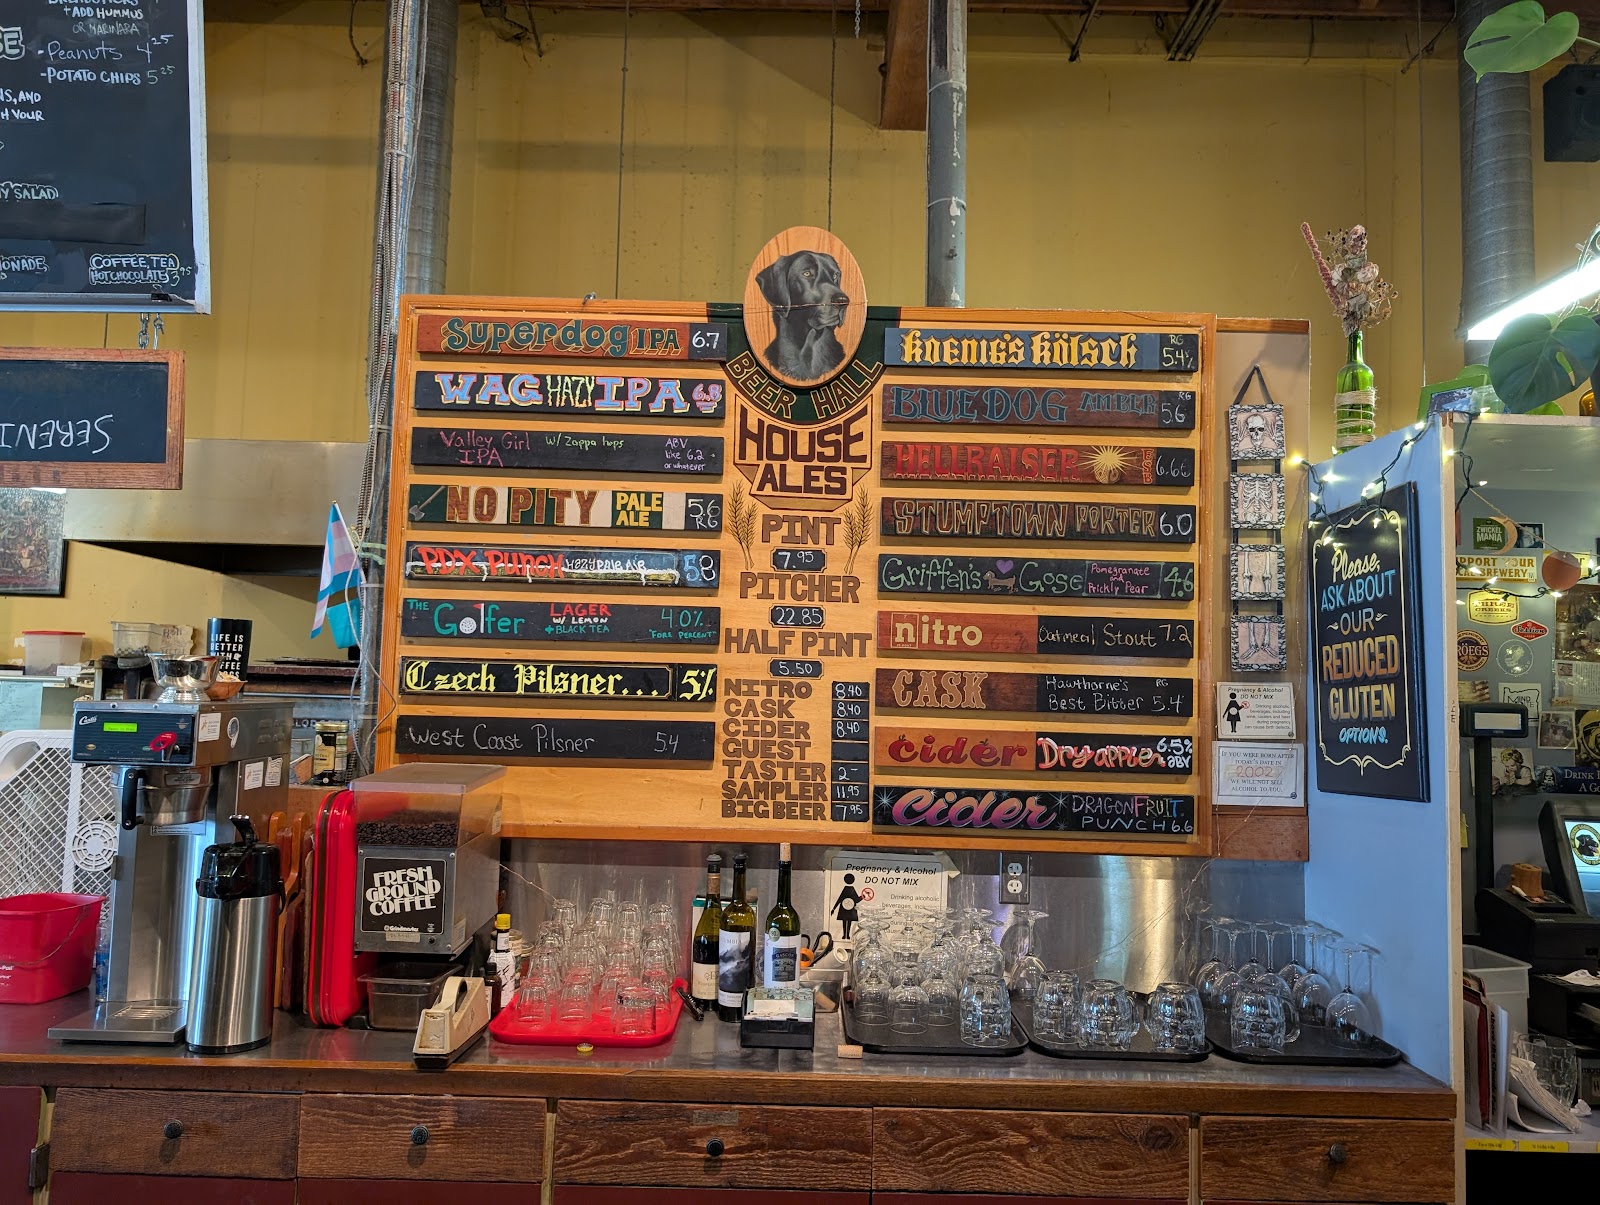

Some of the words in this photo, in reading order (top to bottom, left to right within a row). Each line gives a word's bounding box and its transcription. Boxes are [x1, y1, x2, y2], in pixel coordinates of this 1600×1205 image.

[96, 8, 144, 19] HUMMUS
[72, 25, 86, 34] OR
[88, 22, 140, 36] MARINARA
[100, 72, 141, 85] CHIPS
[19, 91, 42, 104] AND
[12, 109, 45, 121] YOUR
[14, 188, 56, 200] SALAD
[152, 257, 175, 269] TEA
[441, 317, 630, 358] Superdog
[630, 327, 683, 356] IPA
[691, 330, 720, 350] 6.7
[1169, 334, 1184, 346] RG
[435, 373, 543, 405] WAG
[546, 374, 596, 409] HAZY
[595, 376, 691, 414] IPA
[726, 350, 797, 419] BEER
[810, 359, 884, 419] HALL
[890, 386, 980, 421] BLUE
[982, 387, 1068, 423] DOG
[1079, 390, 1158, 416] AMBER
[1178, 391, 1192, 400] RG
[1161, 403, 1186, 424] 5.6
[439, 431, 493, 450] Valley
[502, 431, 531, 451] Girl
[565, 436, 597, 451] Zappa
[602, 436, 625, 449] hops
[665, 437, 689, 449] ABV
[739, 404, 868, 463] HOUSE
[459, 449, 504, 468] IPA
[665, 449, 681, 460] like
[687, 448, 705, 461] 6.2
[893, 443, 1081, 481] HELLRAISER
[673, 462, 706, 471] whatever
[1141, 448, 1154, 484] ESB
[756, 463, 847, 495] ALES
[446, 485, 499, 524] NO
[509, 487, 600, 526] PITY
[616, 491, 663, 513] PALE
[687, 498, 721, 518] 5.6
[615, 510, 650, 528] ALE
[696, 515, 718, 530] RG
[893, 499, 1068, 538] STUMPTOWN
[1075, 504, 1157, 538] PORTER
[1159, 510, 1193, 537] 6.0
[762, 514, 842, 546] PINT
[1476, 532, 1502, 543] MANIA
[417, 546, 480, 576] PDX
[683, 553, 716, 582] 5.8
[778, 551, 814, 570] 7.95
[1091, 562, 1151, 576] Pomegranate
[1331, 549, 1381, 583] Please,
[882, 557, 981, 591] Griffen's
[1019, 561, 1085, 595] Gose
[1110, 574, 1124, 583] and
[1163, 566, 1194, 597] 4.6
[1480, 569, 1528, 578] BREWERY
[740, 571, 861, 604] PITCHER
[1088, 581, 1121, 596] Prickly
[1125, 583, 1149, 594] Pear
[1321, 583, 1345, 612] ASK
[1347, 569, 1396, 605] ABOUT
[406, 599, 430, 611] THE
[550, 603, 612, 617] LAGER
[433, 603, 526, 636] Golfer
[571, 616, 609, 625] LEMON
[775, 606, 823, 625] 22.85
[1339, 607, 1375, 636] OUR
[211, 633, 231, 642] LIFE
[234, 634, 244, 642] IS
[589, 625, 610, 634] TEA
[894, 614, 983, 647] nitro
[1038, 624, 1095, 644] Oatmeal
[1103, 623, 1157, 648] Stout
[1158, 624, 1193, 648] 7.2
[210, 642, 244, 652] BETTER
[725, 628, 796, 655] HALF
[801, 631, 872, 658] PINT
[778, 661, 813, 676] 5.50
[1322, 634, 1400, 684] REDUCED
[406, 660, 497, 692] Czech
[679, 667, 717, 701] 5%
[1046, 675, 1129, 692] Hawthorne's
[1155, 679, 1169, 688] RG
[724, 678, 813, 699] NITRO
[834, 682, 862, 700] 8.40
[892, 670, 989, 710] CASK
[724, 698, 796, 719] CASK
[836, 701, 861, 718] 8.40
[1048, 694, 1087, 711] Best
[1093, 693, 1144, 711] Bitter
[1151, 694, 1183, 713] 5.4
[1329, 682, 1396, 722] GLUTEN
[410, 726, 464, 748] West
[473, 723, 523, 750] Coast
[531, 723, 598, 753] Pilsner
[722, 718, 811, 740] CIDER
[836, 721, 860, 738] 8.40
[1338, 726, 1388, 745] OPTIONS.
[655, 732, 679, 753] 5.4
[722, 738, 812, 761] GUEST
[1156, 737, 1193, 756] 6.5%
[1037, 737, 1095, 769] Dry
[722, 760, 827, 782] TASTER
[1236, 765, 1273, 778] 2002
[1564, 769, 1595, 780] DRINK
[721, 780, 828, 801] SAMPLER
[836, 785, 860, 799] 11.95
[1579, 783, 1587, 792] A
[721, 800, 770, 819] BIG
[772, 801, 827, 820] BEER
[835, 804, 863, 821] 7.95
[892, 787, 1057, 830] Cider
[1081, 815, 1166, 831] PUNCH
[1171, 821, 1194, 833] 6.6
[373, 865, 434, 887] FRESH
[845, 863, 893, 875] Pregnancy
[903, 866, 937, 875] Alcohol
[365, 879, 441, 902] GROUND
[864, 876, 879, 884] DO
[880, 877, 901, 885] NOT
[902, 878, 919, 886] MIX
[369, 893, 437, 916] COFFEE
[890, 893, 914, 902] Drinking
